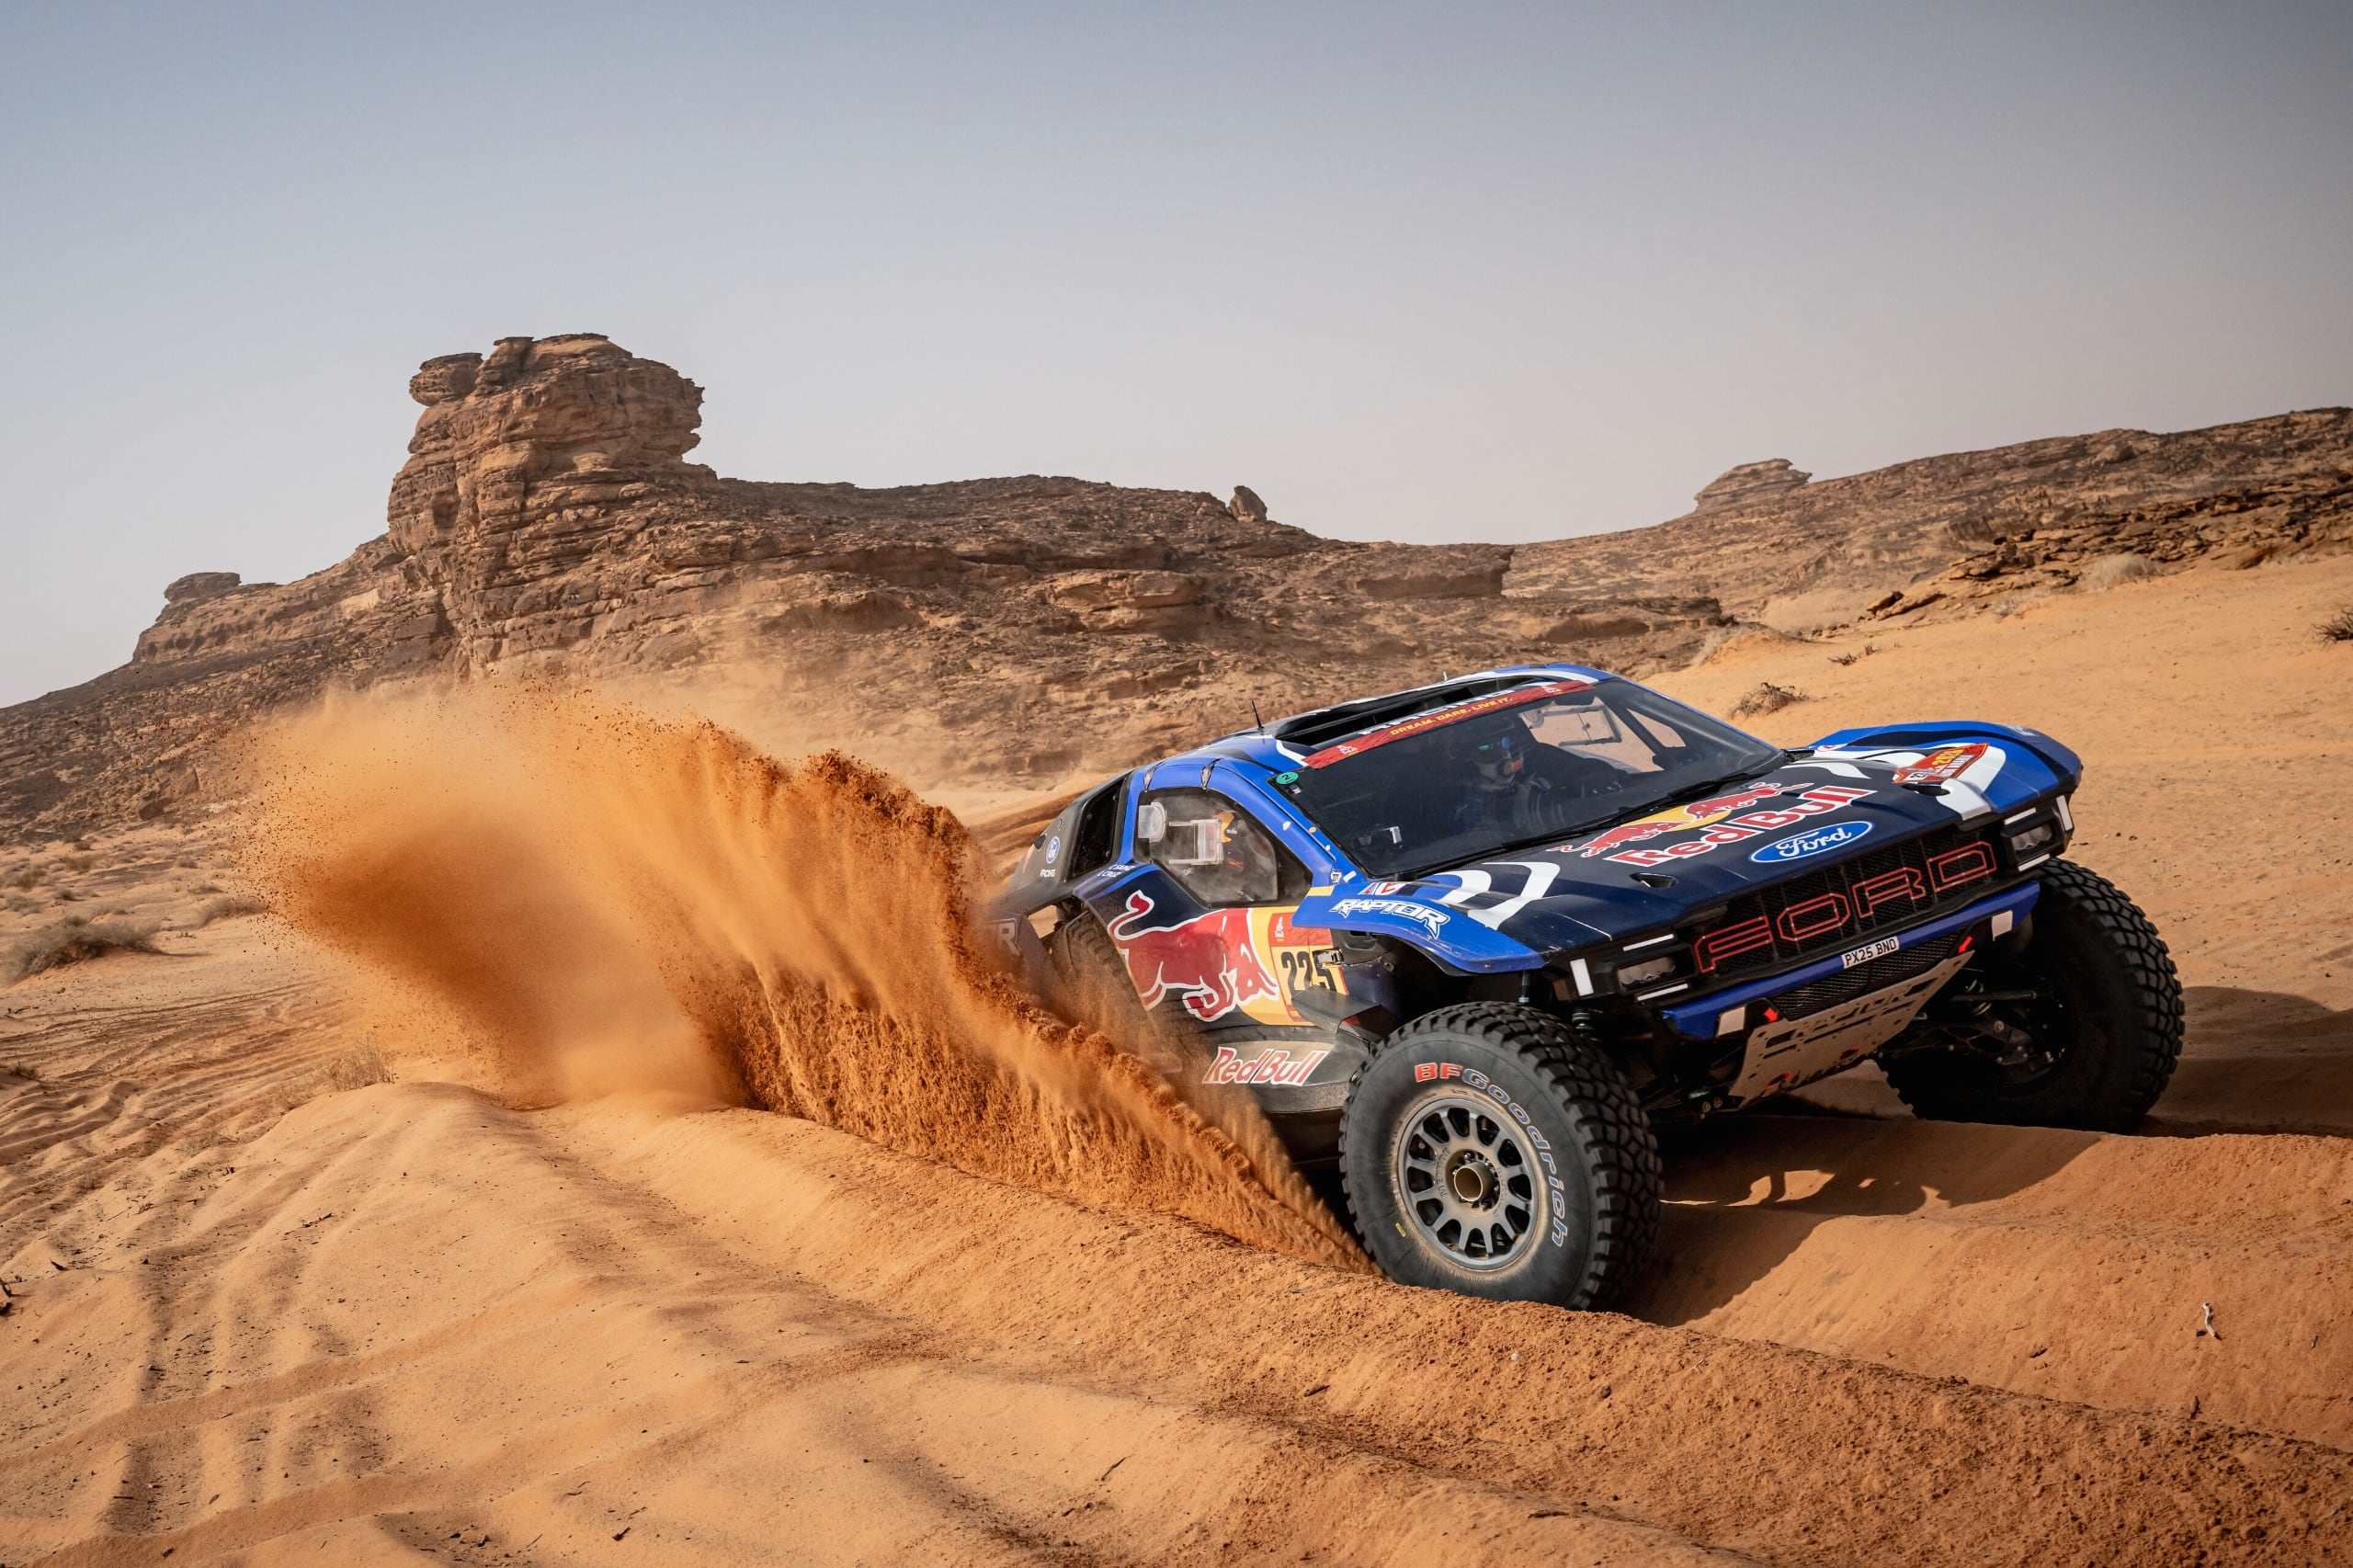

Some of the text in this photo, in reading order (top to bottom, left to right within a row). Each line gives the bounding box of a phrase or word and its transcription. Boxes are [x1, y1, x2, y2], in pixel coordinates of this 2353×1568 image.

[1390, 719, 1436, 736] DREAM.
[1436, 708, 1472, 721] DARE.
[1471, 699, 1498, 711] LIVE
[1281, 771, 1291, 781] 2
[1602, 785, 1878, 868] Red Bull
[1775, 826, 1853, 858] Ford
[1329, 898, 1451, 941] RAPTOR
[1695, 841, 1997, 973] FORD
[1844, 938, 1897, 966] PX25 BND
[1280, 950, 1337, 996] 225
[1202, 1046, 1331, 1086] Red Bull
